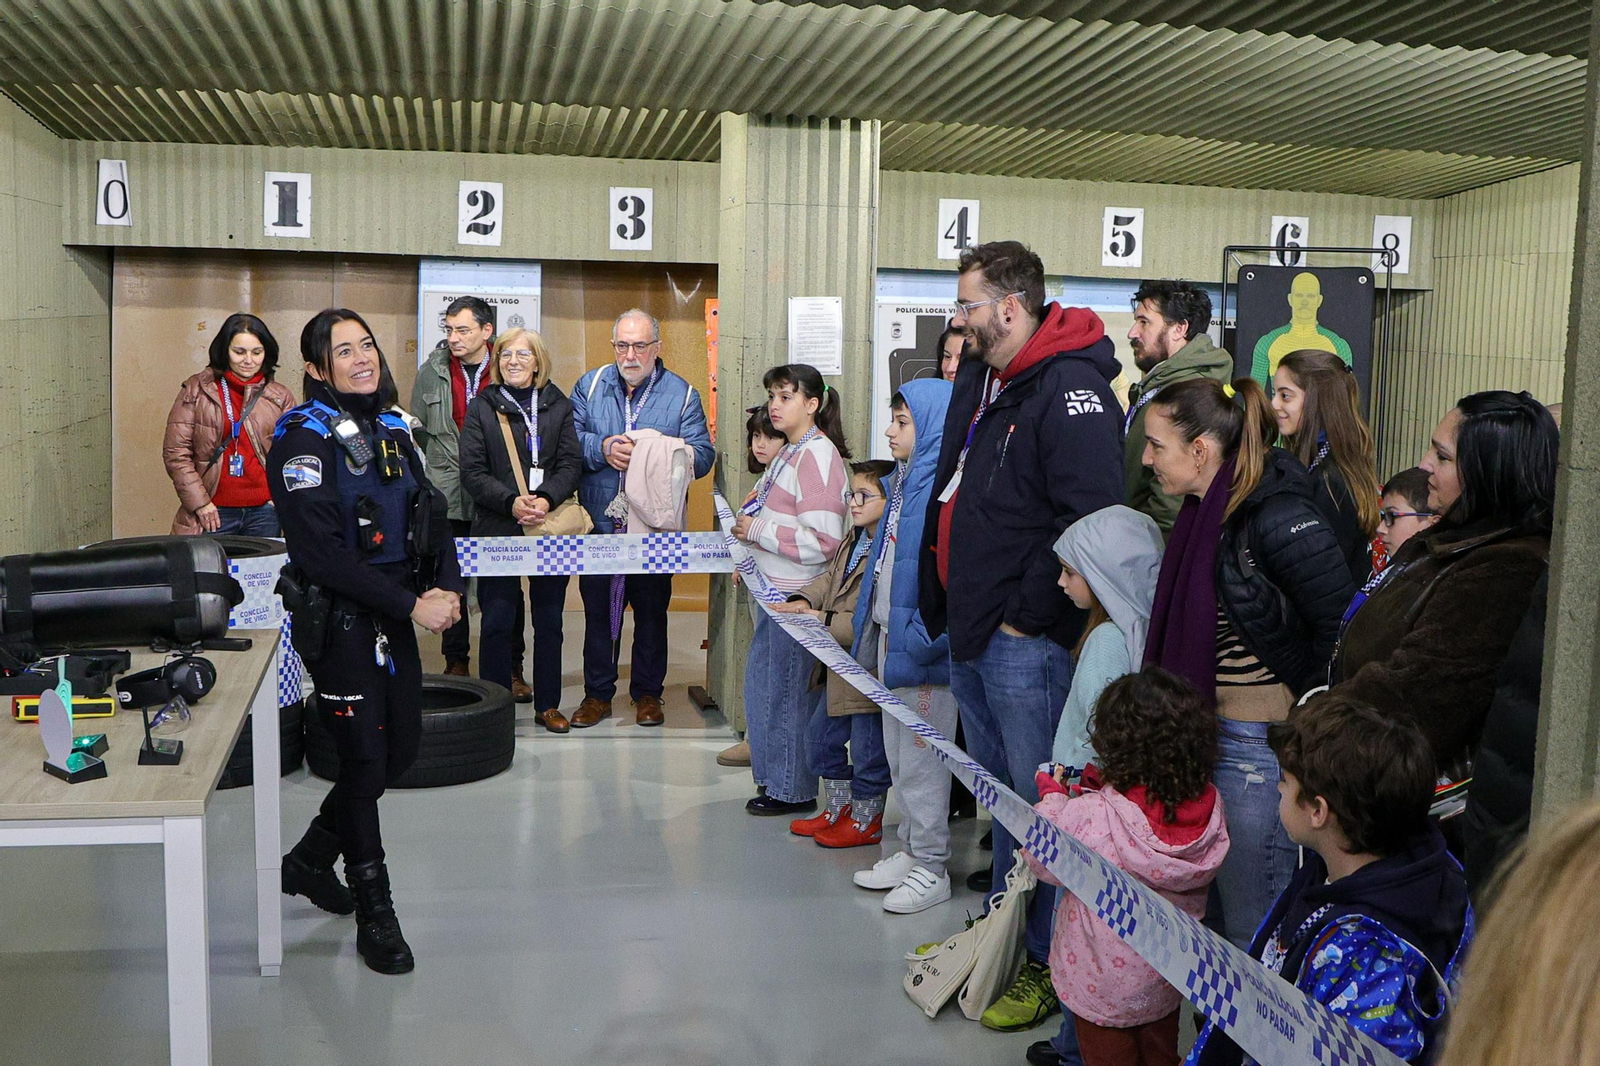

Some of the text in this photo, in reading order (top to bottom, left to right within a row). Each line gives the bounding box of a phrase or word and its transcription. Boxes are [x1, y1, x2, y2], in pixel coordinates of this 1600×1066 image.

[103, 179, 128, 219] 0
[272, 181, 303, 227] 1
[466, 190, 496, 235] 2
[616, 195, 645, 240] 3
[944, 206, 972, 249] 4
[1109, 214, 1136, 258] 5
[1276, 223, 1301, 267] 6
[1381, 233, 1400, 268] 8
[243, 571, 272, 580] CONCELLO
[257, 579, 269, 587] VIGO
[240, 606, 269, 618] CONCELLO
[244, 614, 267, 624] DE VIGO
[1256, 998, 1296, 1044] NO PASAR
[1275, 993, 1304, 1026] LOCAL
